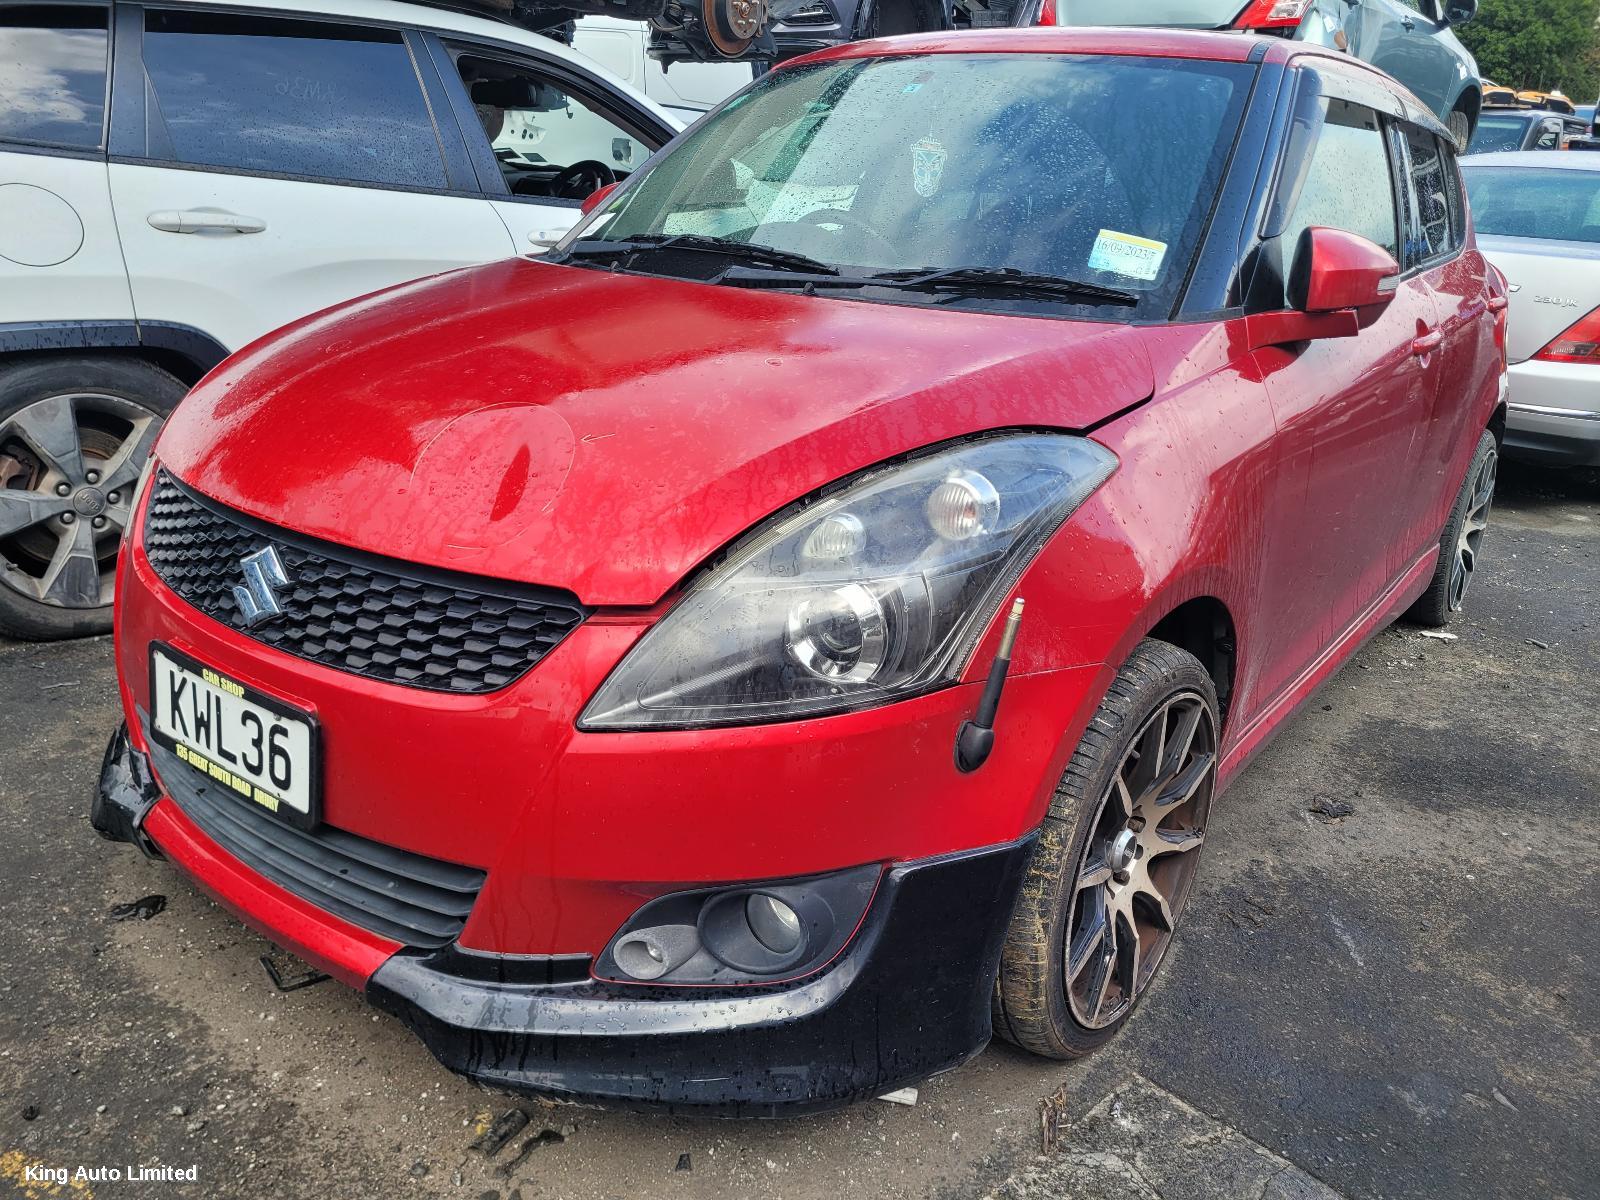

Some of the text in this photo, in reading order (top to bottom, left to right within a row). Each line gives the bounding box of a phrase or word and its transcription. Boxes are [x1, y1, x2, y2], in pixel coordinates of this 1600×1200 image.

[80, 493, 100, 511] Jeep
[202, 668, 245, 698] CAR SHOP
[169, 669, 292, 791] KWL36
[176, 743, 280, 813] 135 GREAT SOUTH ROAD DRURY
